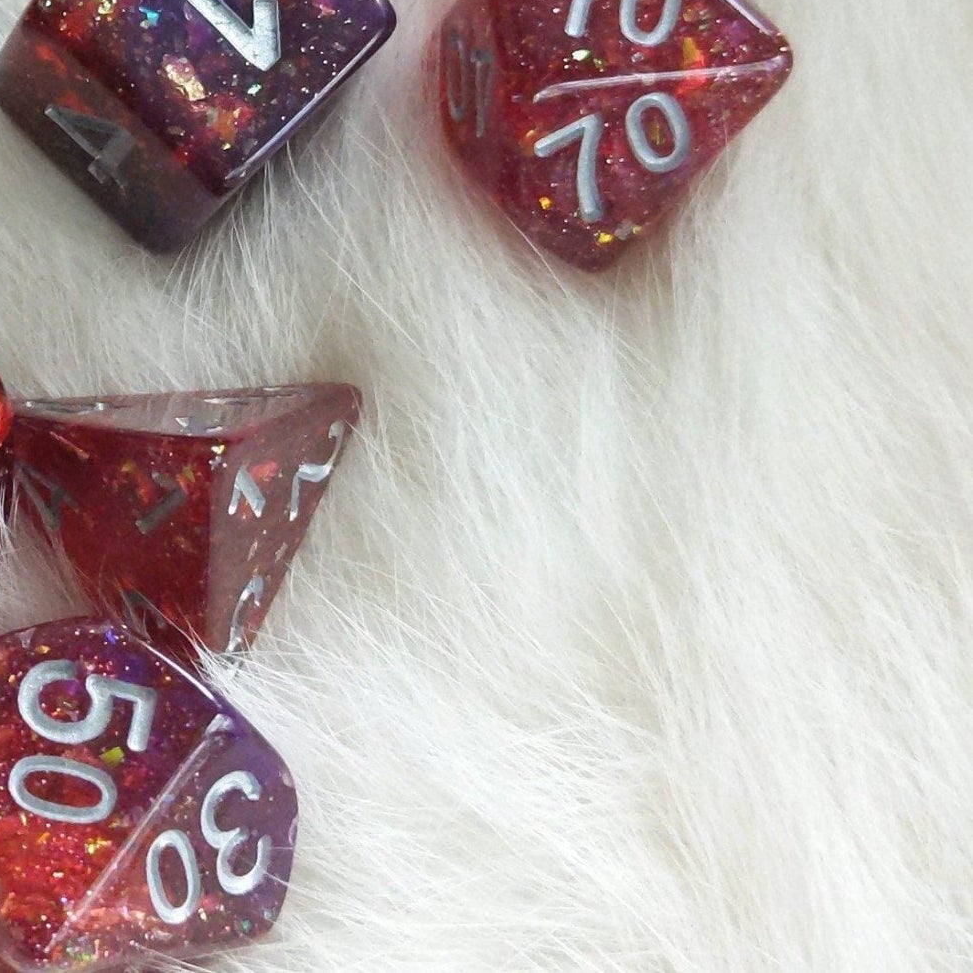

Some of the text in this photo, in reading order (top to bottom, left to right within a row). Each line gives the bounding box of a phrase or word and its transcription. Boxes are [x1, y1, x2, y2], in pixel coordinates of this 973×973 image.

[44, 103, 137, 192] 4
[533, 91, 692, 223] 70
[8, 659, 158, 825] 50
[145, 770, 274, 926] 30
